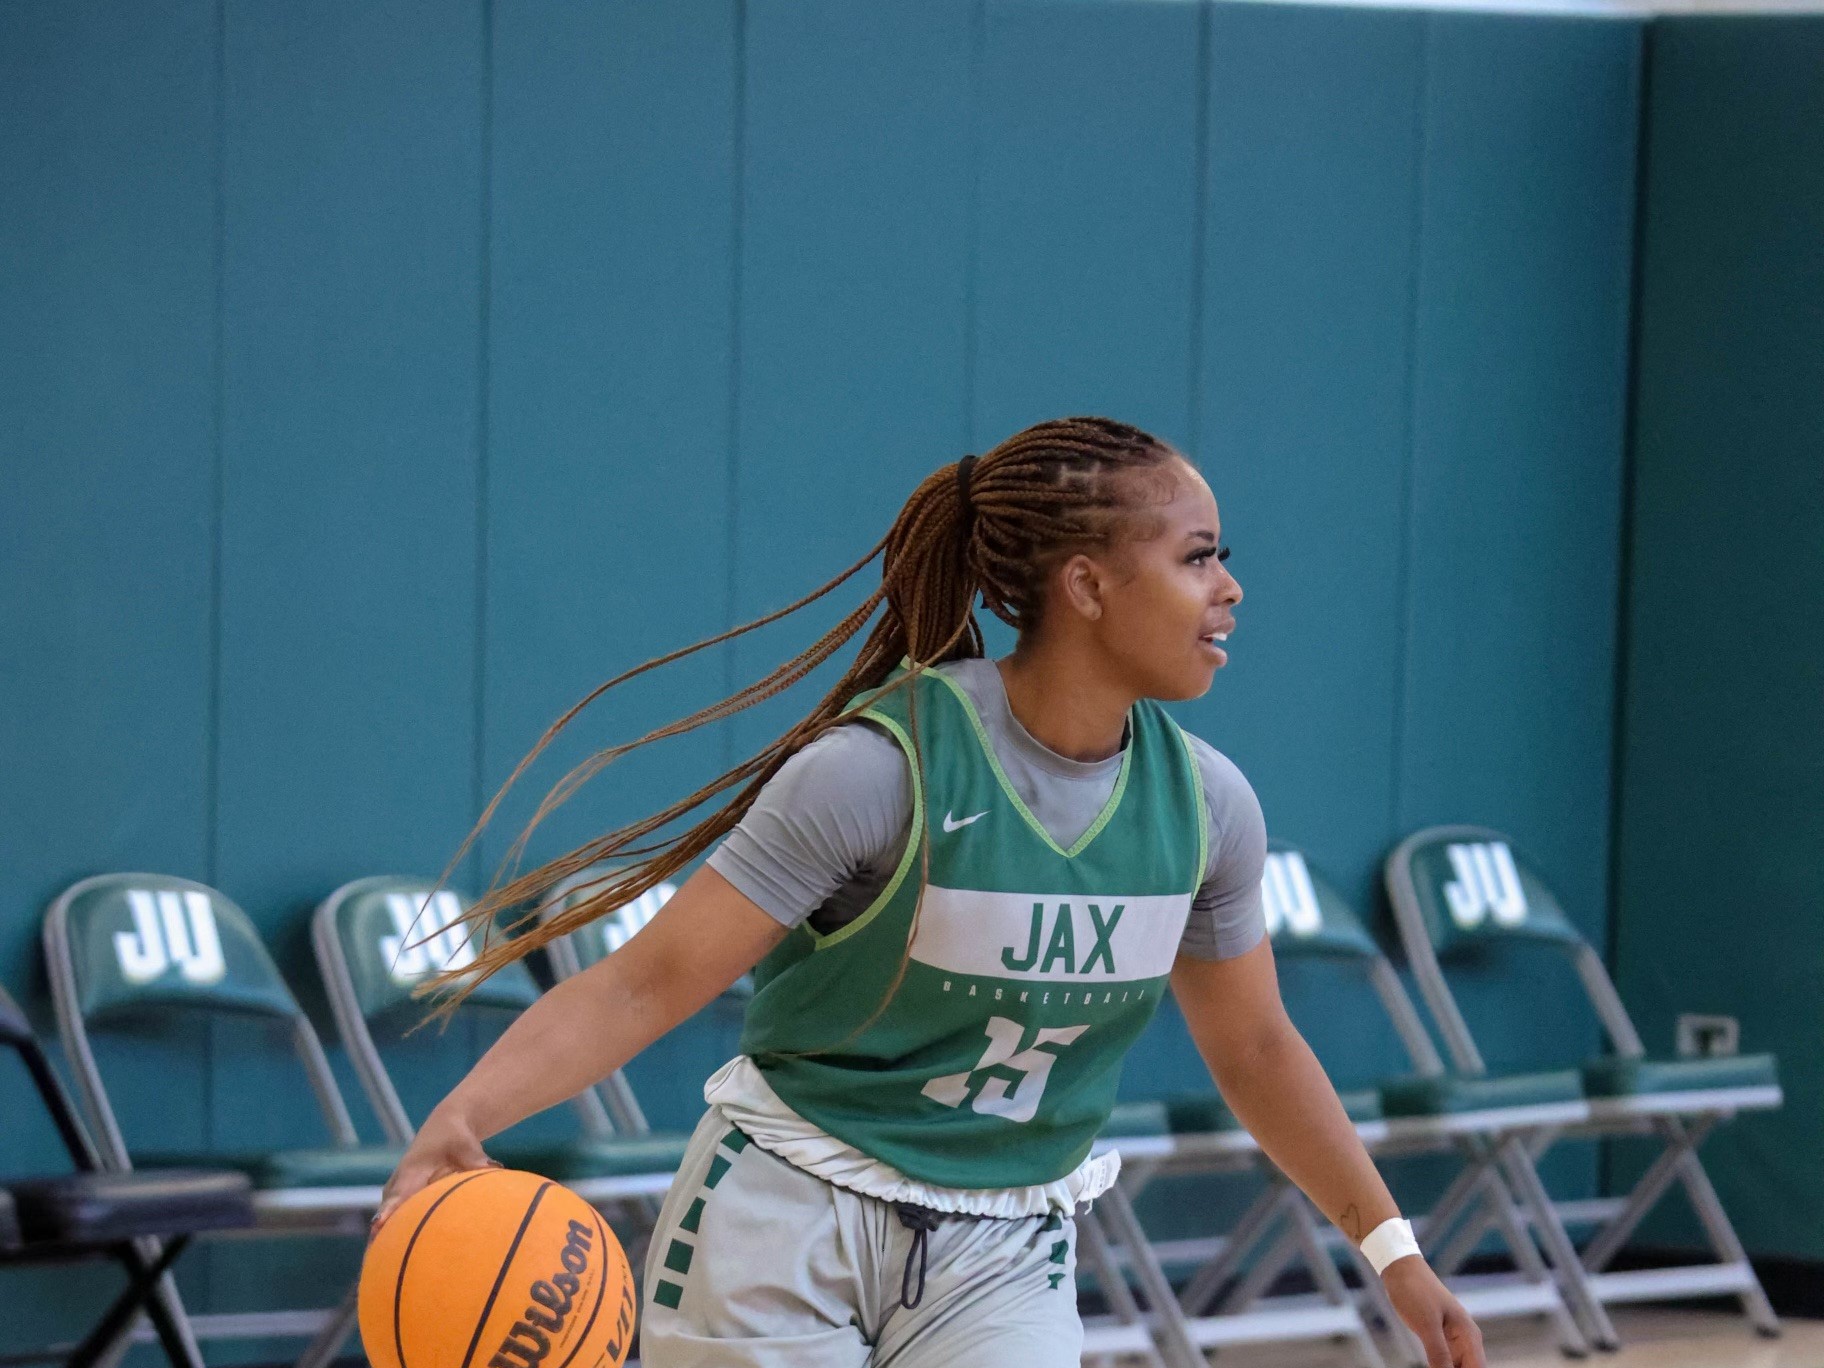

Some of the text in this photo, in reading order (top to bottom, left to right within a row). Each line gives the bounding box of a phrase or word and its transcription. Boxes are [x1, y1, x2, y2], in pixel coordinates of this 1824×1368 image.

[1261, 851, 1322, 936] U
[1444, 842, 1528, 926] JU
[114, 889, 225, 983] JU
[380, 890, 477, 985] JU
[1000, 902, 1126, 974] JAX
[920, 1016, 1091, 1122] 15
